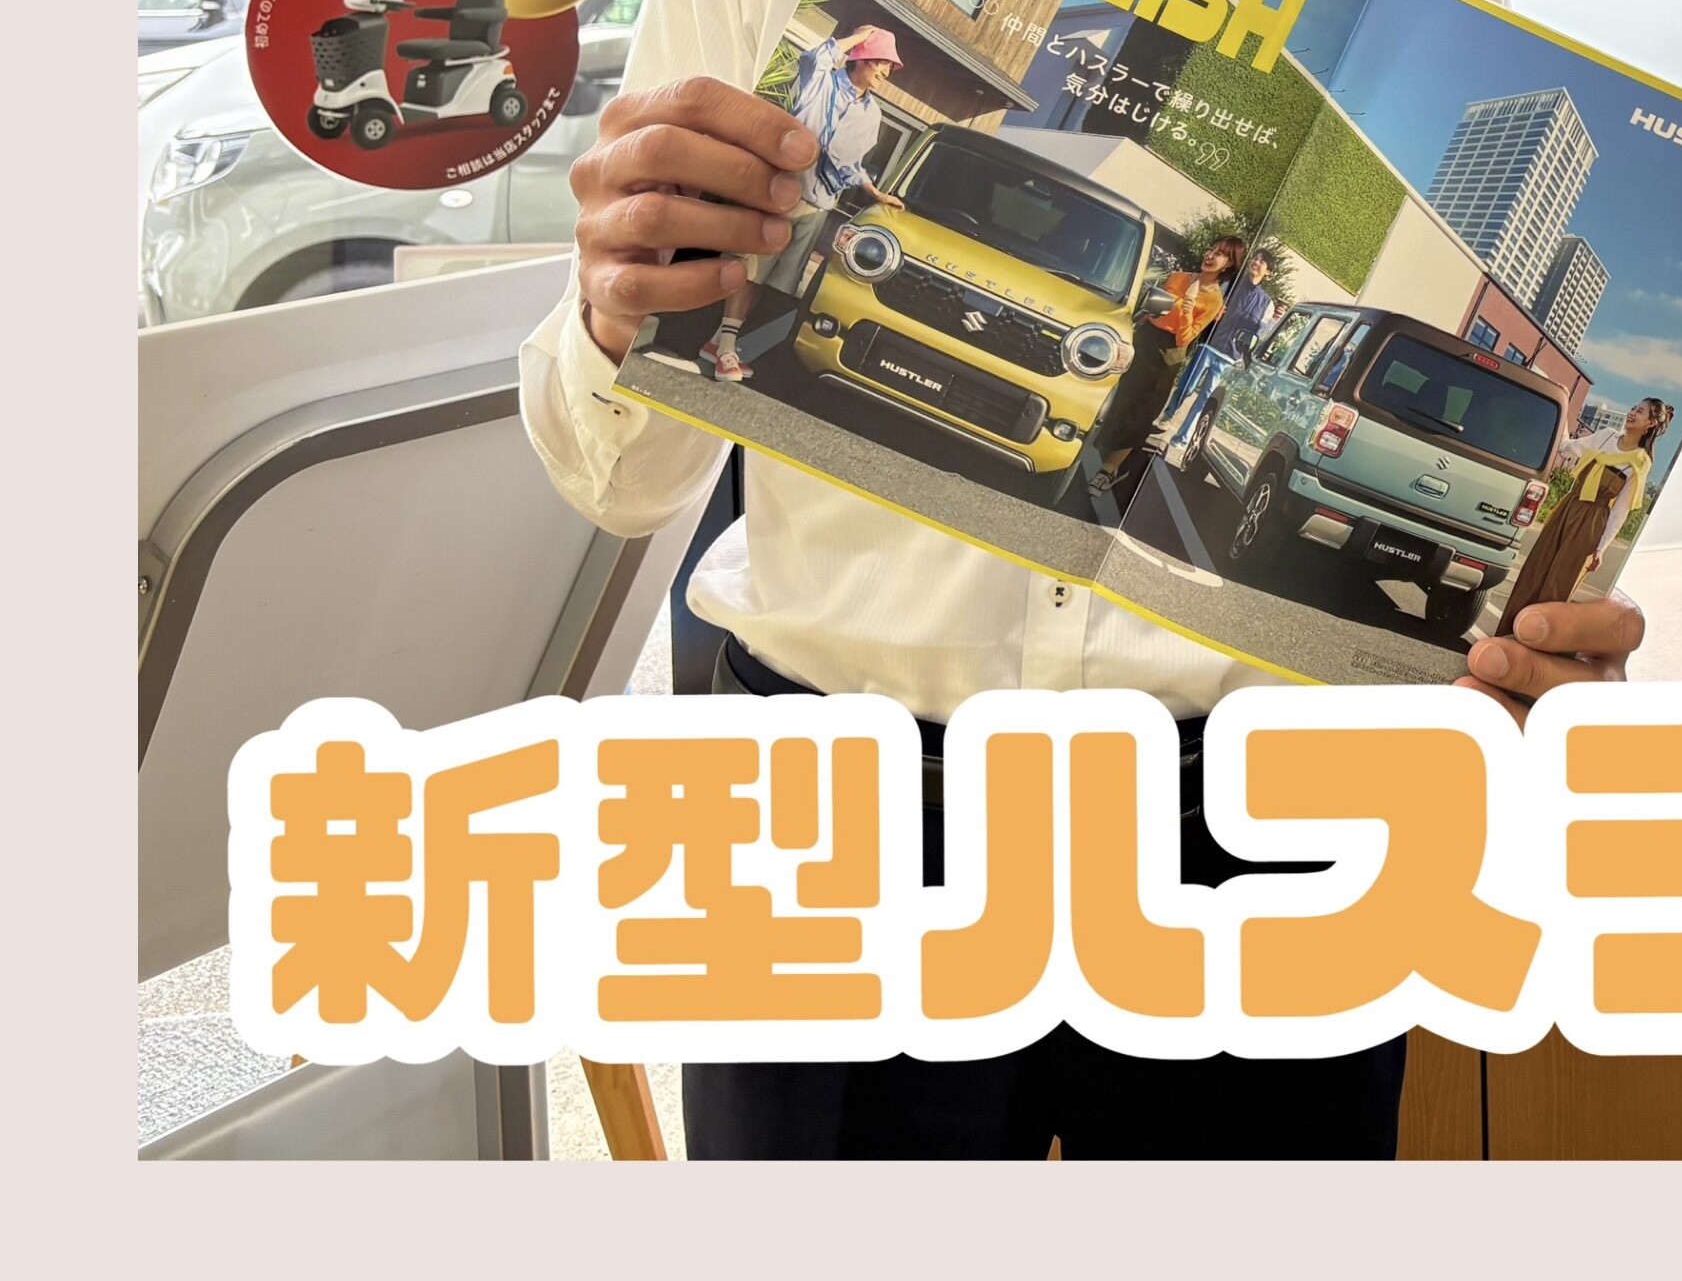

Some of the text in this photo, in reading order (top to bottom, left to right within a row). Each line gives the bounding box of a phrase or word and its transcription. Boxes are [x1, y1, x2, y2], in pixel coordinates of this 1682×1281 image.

[1001, 12, 1279, 150] 仲間とハスラーで繰り出せば、
[1061, 71, 1198, 148] 気分はじける。
[446, 86, 561, 179] ご相談は当店スタッフまで
[880, 359, 943, 393] HUSTLER
[1373, 541, 1422, 563] HUSTLER
